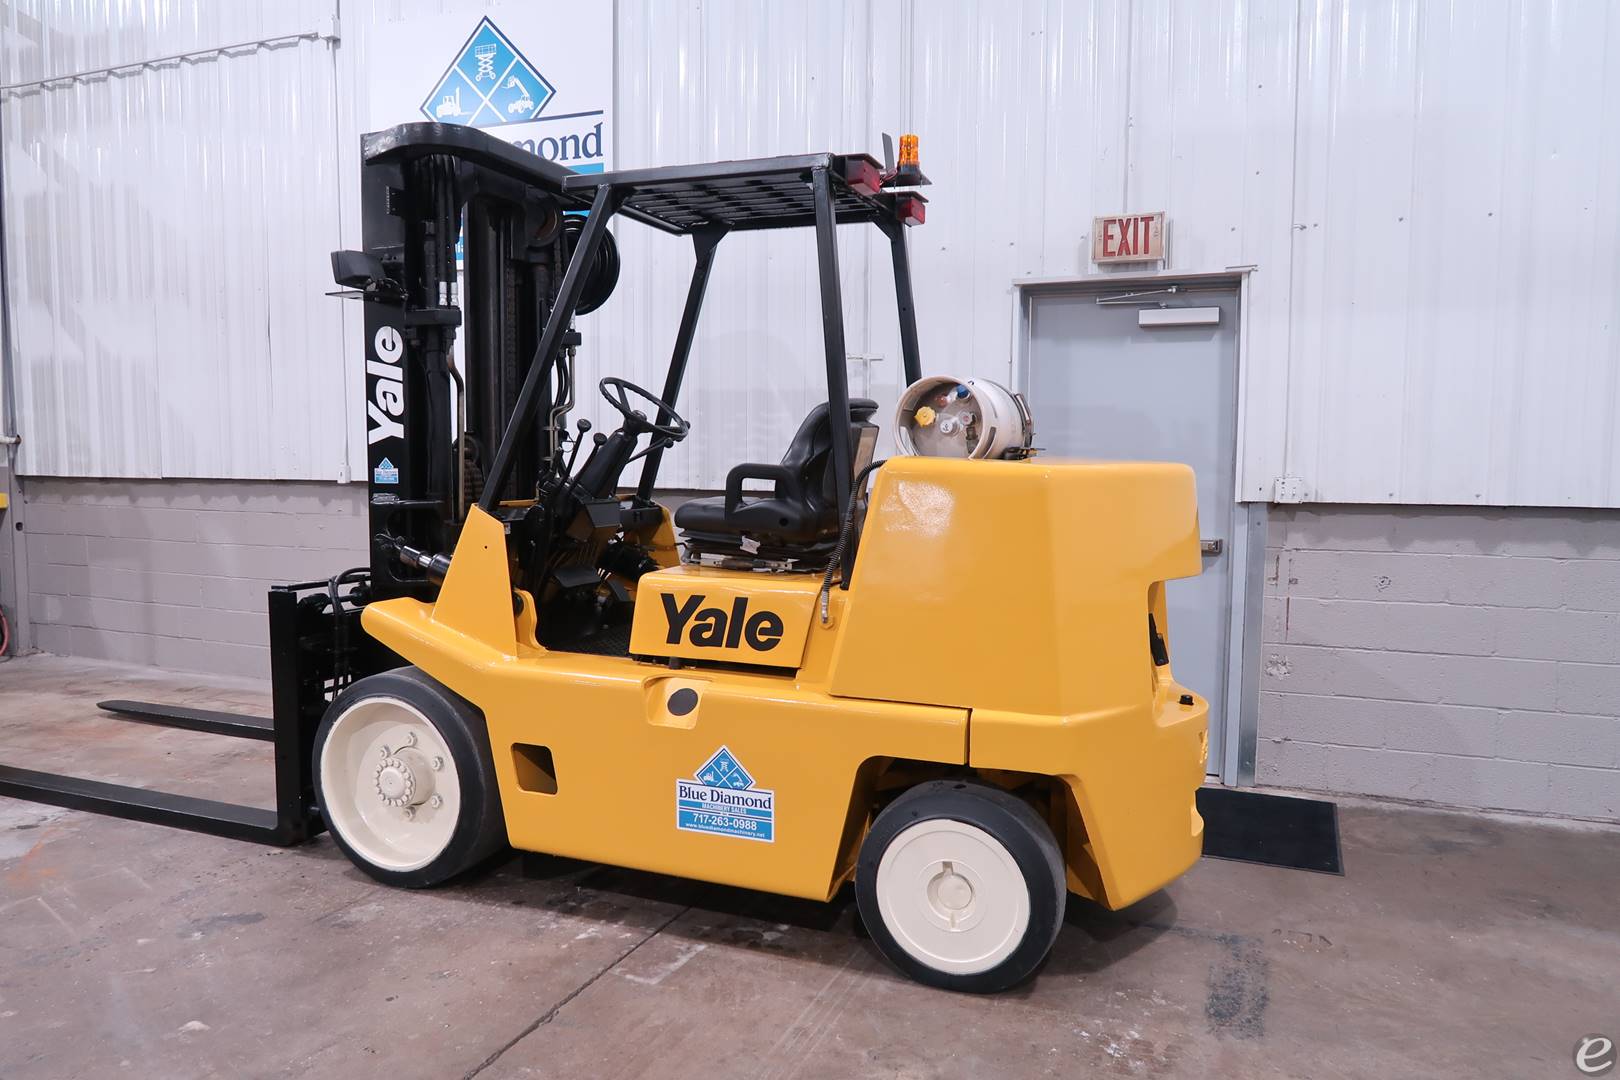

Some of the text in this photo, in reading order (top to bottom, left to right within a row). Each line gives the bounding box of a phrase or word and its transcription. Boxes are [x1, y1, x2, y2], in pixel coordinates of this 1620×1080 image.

[1102, 216, 1155, 257] EXIT
[366, 325, 405, 445] Yale
[660, 592, 784, 652] Yale
[679, 785, 772, 810] Blue Diamond
[692, 813, 758, 831] 717-263-0988
